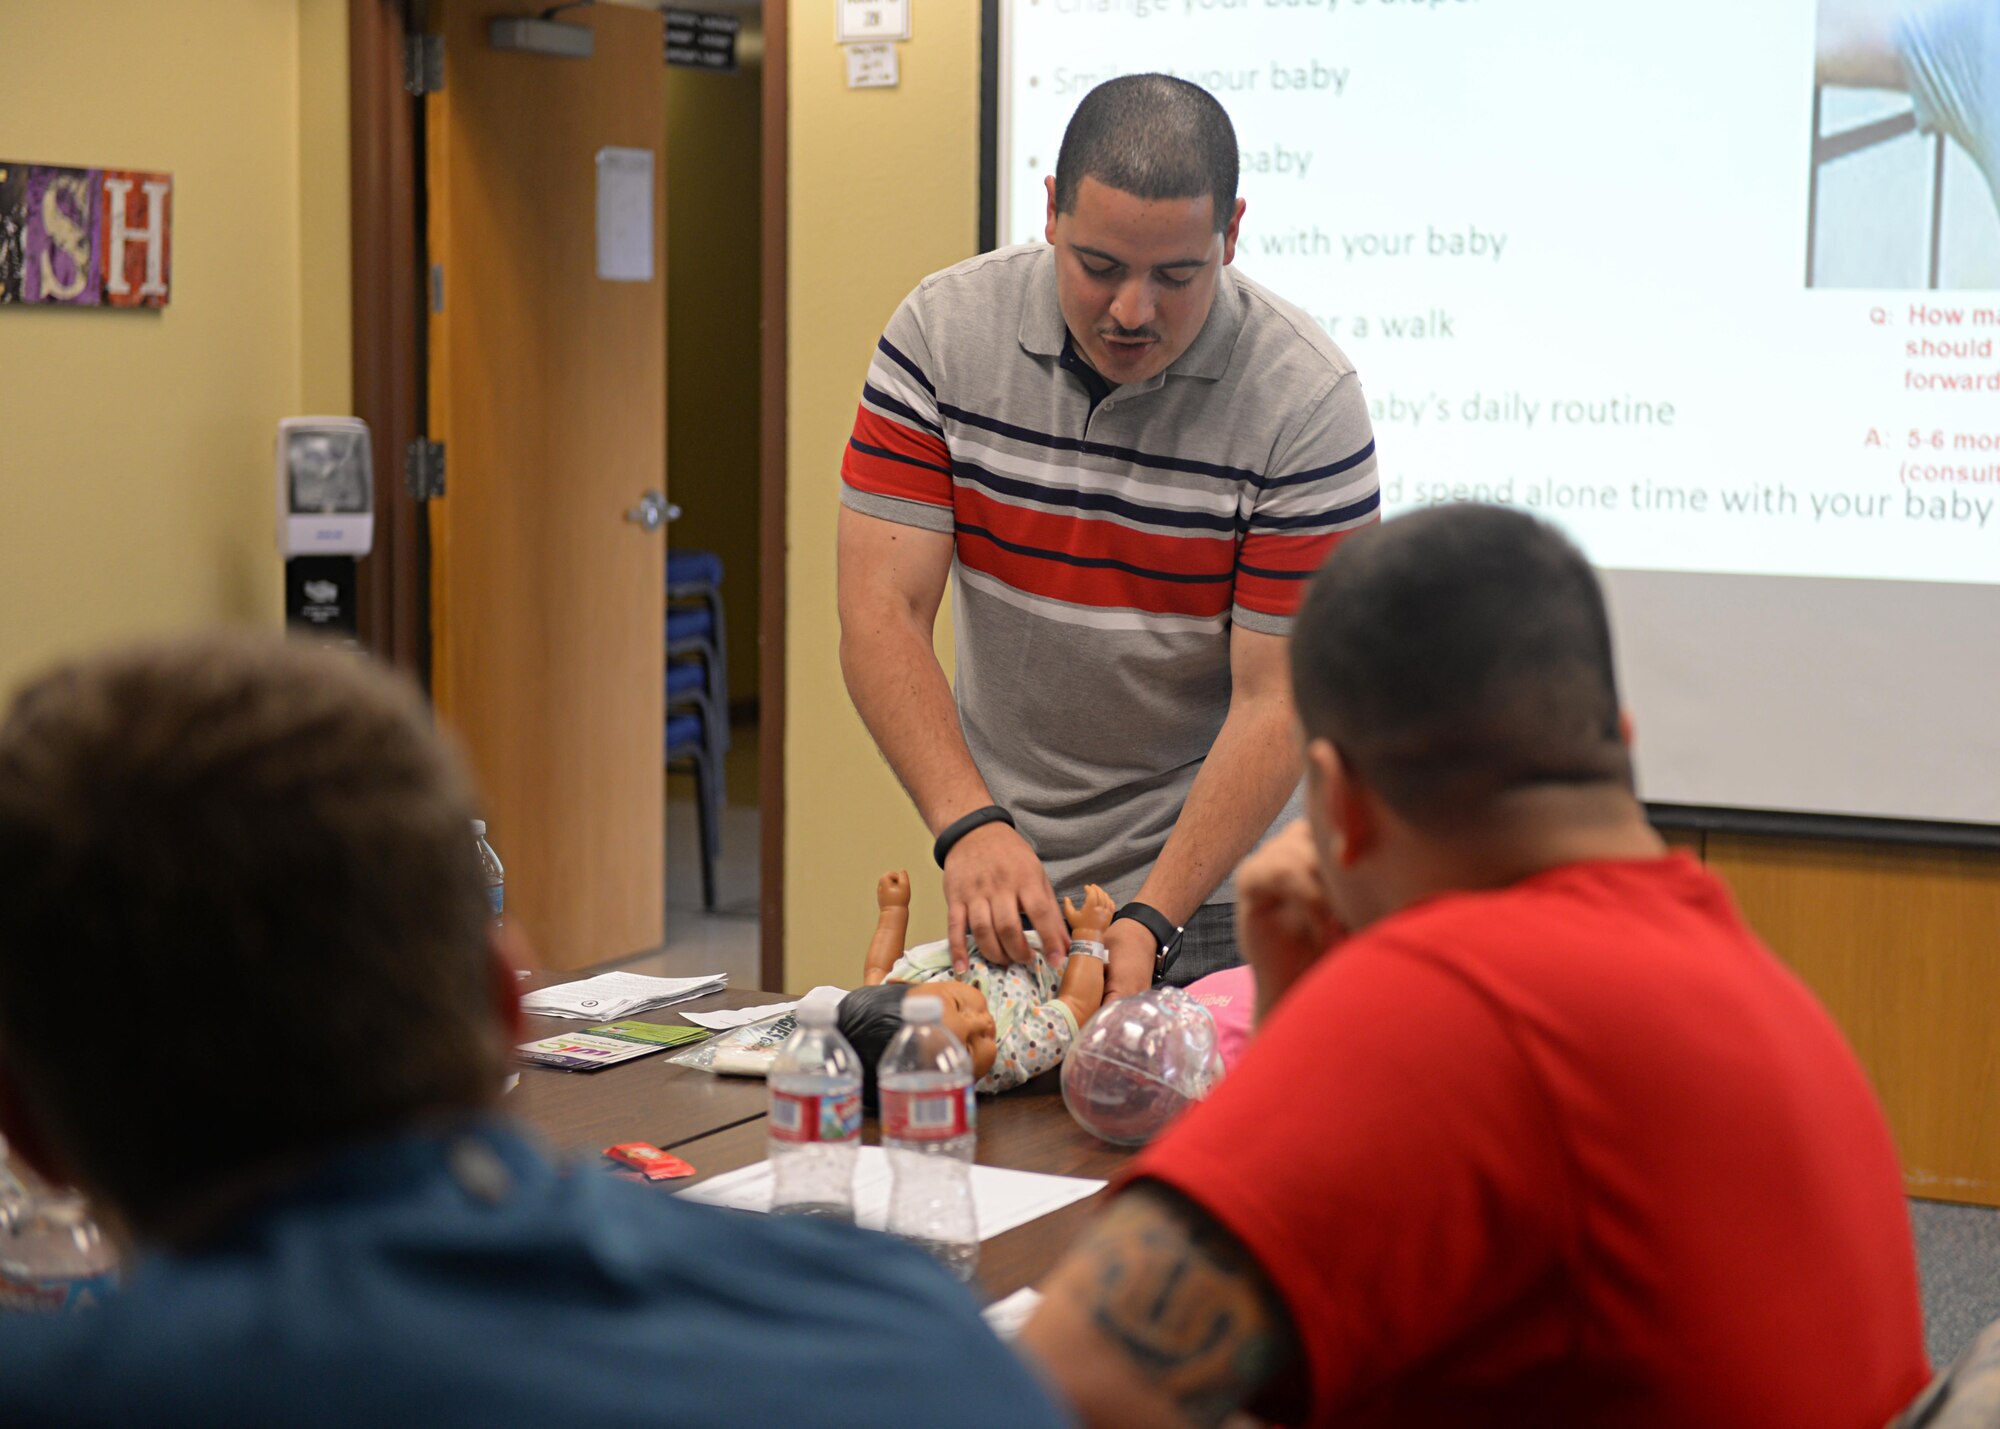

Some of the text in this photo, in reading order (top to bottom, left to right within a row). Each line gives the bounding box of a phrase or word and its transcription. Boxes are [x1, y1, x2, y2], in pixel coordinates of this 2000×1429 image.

[1271, 61, 1349, 95] baby
[1261, 224, 1331, 255] with
[1342, 231, 1415, 262] your
[1427, 225, 1508, 262] baby
[1352, 315, 1368, 338] a
[1381, 308, 1455, 338] walk
[1909, 304, 1964, 325] How
[1905, 338, 1992, 358] should
[1370, 391, 1676, 427] aby's daily routine
[1908, 428, 1944, 450] 5-6
[1415, 476, 1515, 507] spend
[1526, 477, 1618, 508] alone
[1631, 479, 1707, 513] time
[1721, 481, 1797, 515] with
[1811, 491, 1892, 523] your
[1905, 487, 1994, 528] baby
